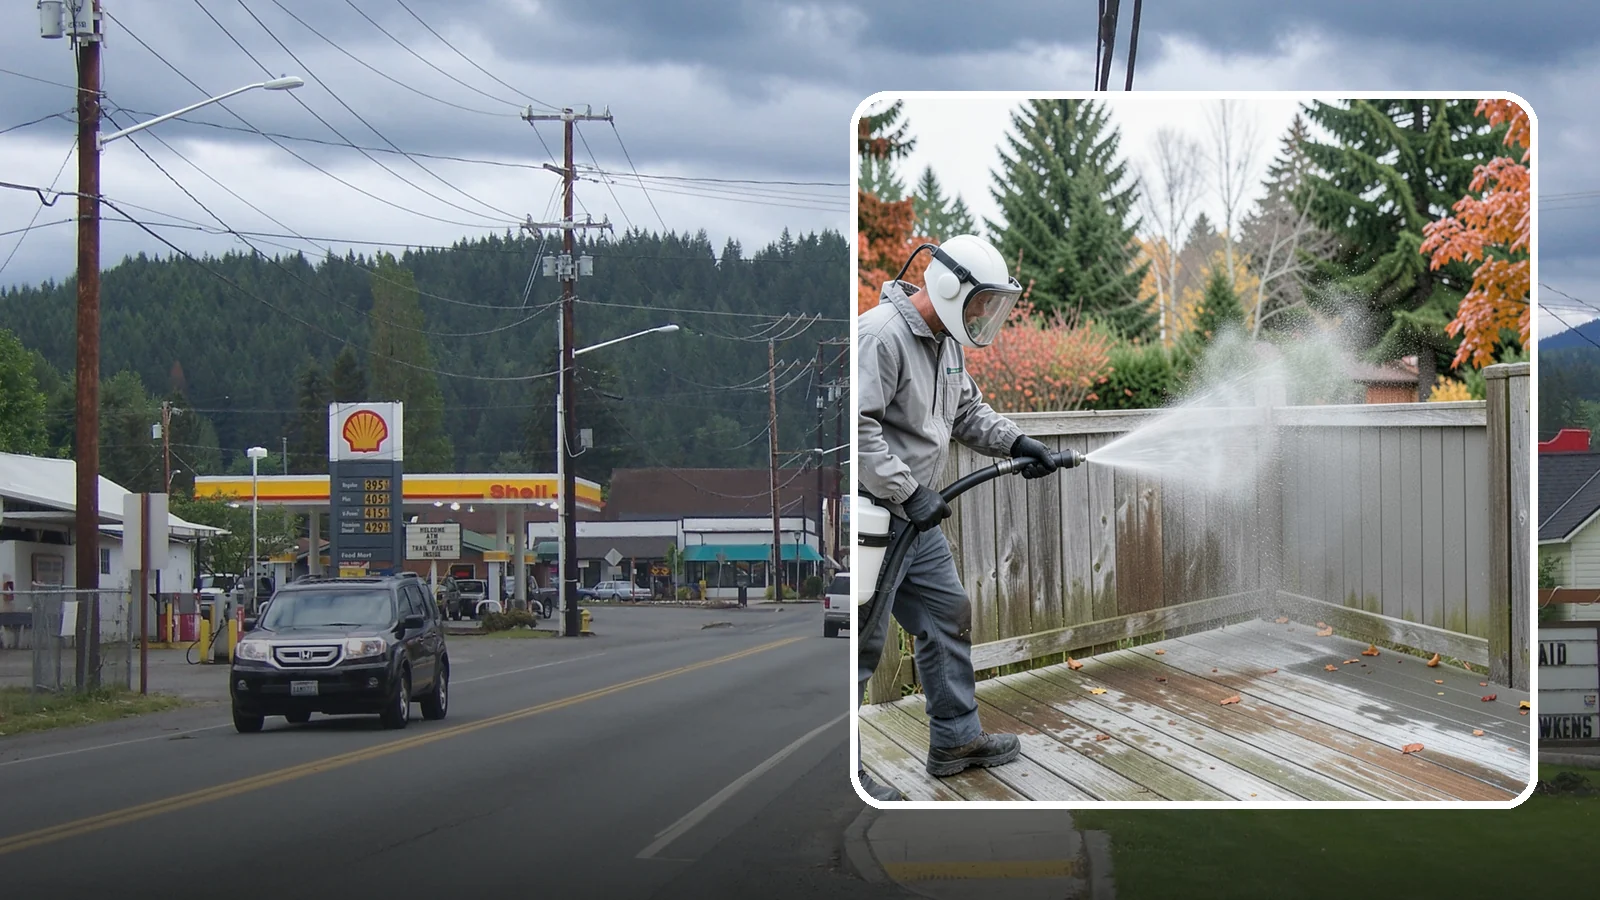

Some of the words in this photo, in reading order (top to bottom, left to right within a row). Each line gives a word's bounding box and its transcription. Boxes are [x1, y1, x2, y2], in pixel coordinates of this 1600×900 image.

[490, 484, 547, 499] Shell
[1538, 643, 1567, 666] AID
[1538, 716, 1592, 739] WKENS
